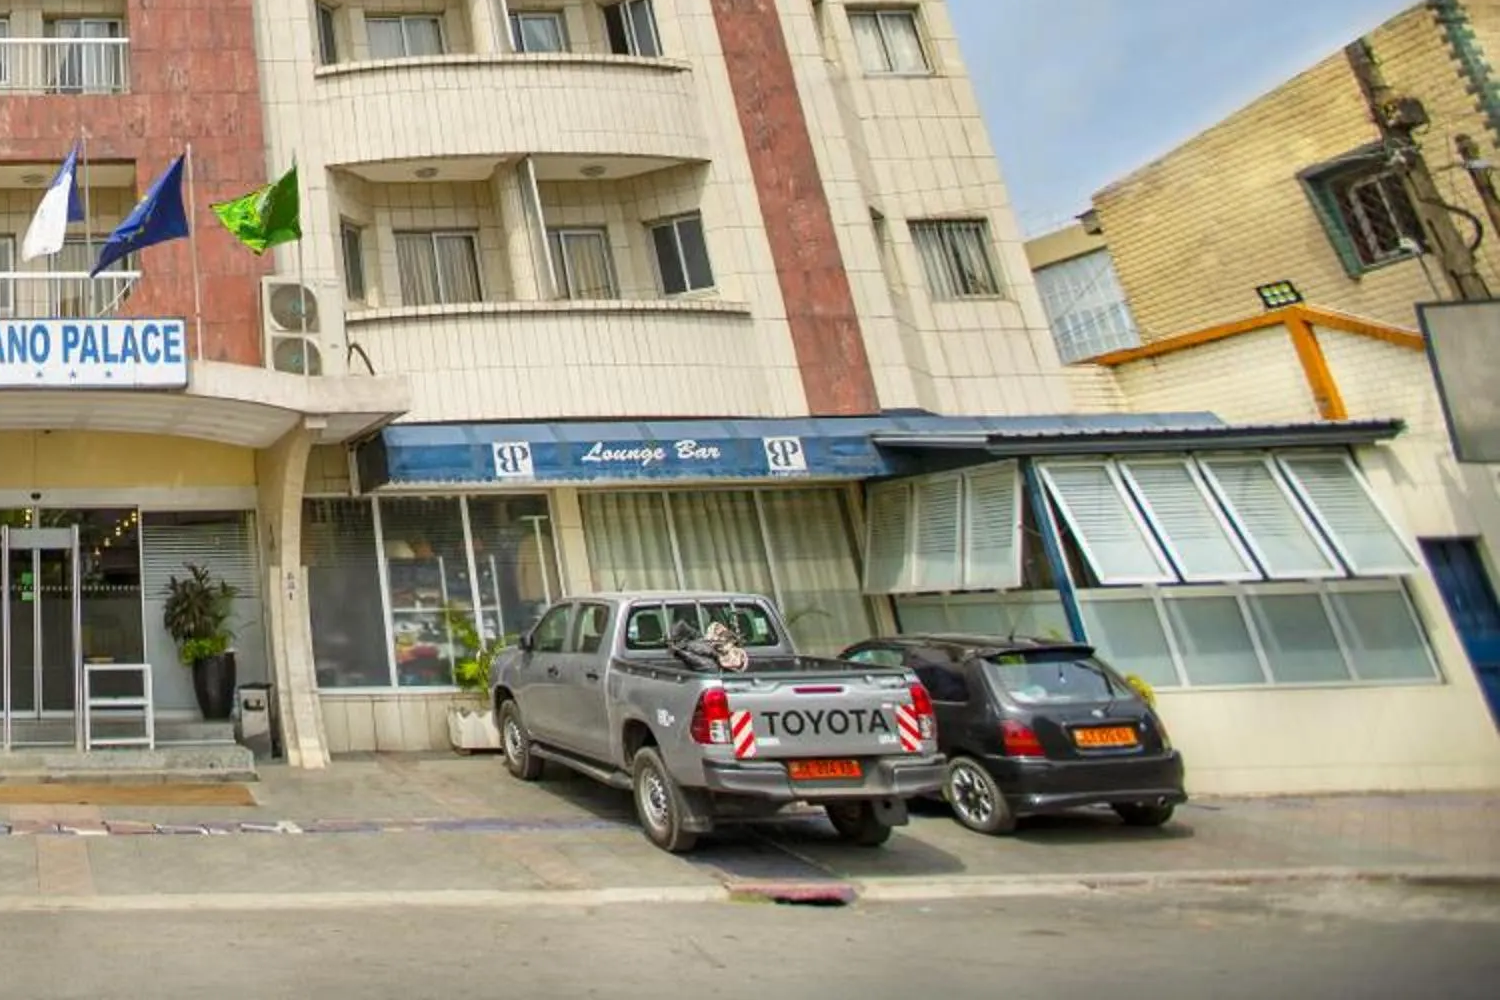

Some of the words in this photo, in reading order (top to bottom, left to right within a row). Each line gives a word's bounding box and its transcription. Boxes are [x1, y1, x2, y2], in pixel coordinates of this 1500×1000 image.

[61, 323, 182, 364] PALACE
[580, 442, 667, 466] Lounge
[674, 439, 721, 459] Bar
[760, 709, 891, 735] TOYOTA
